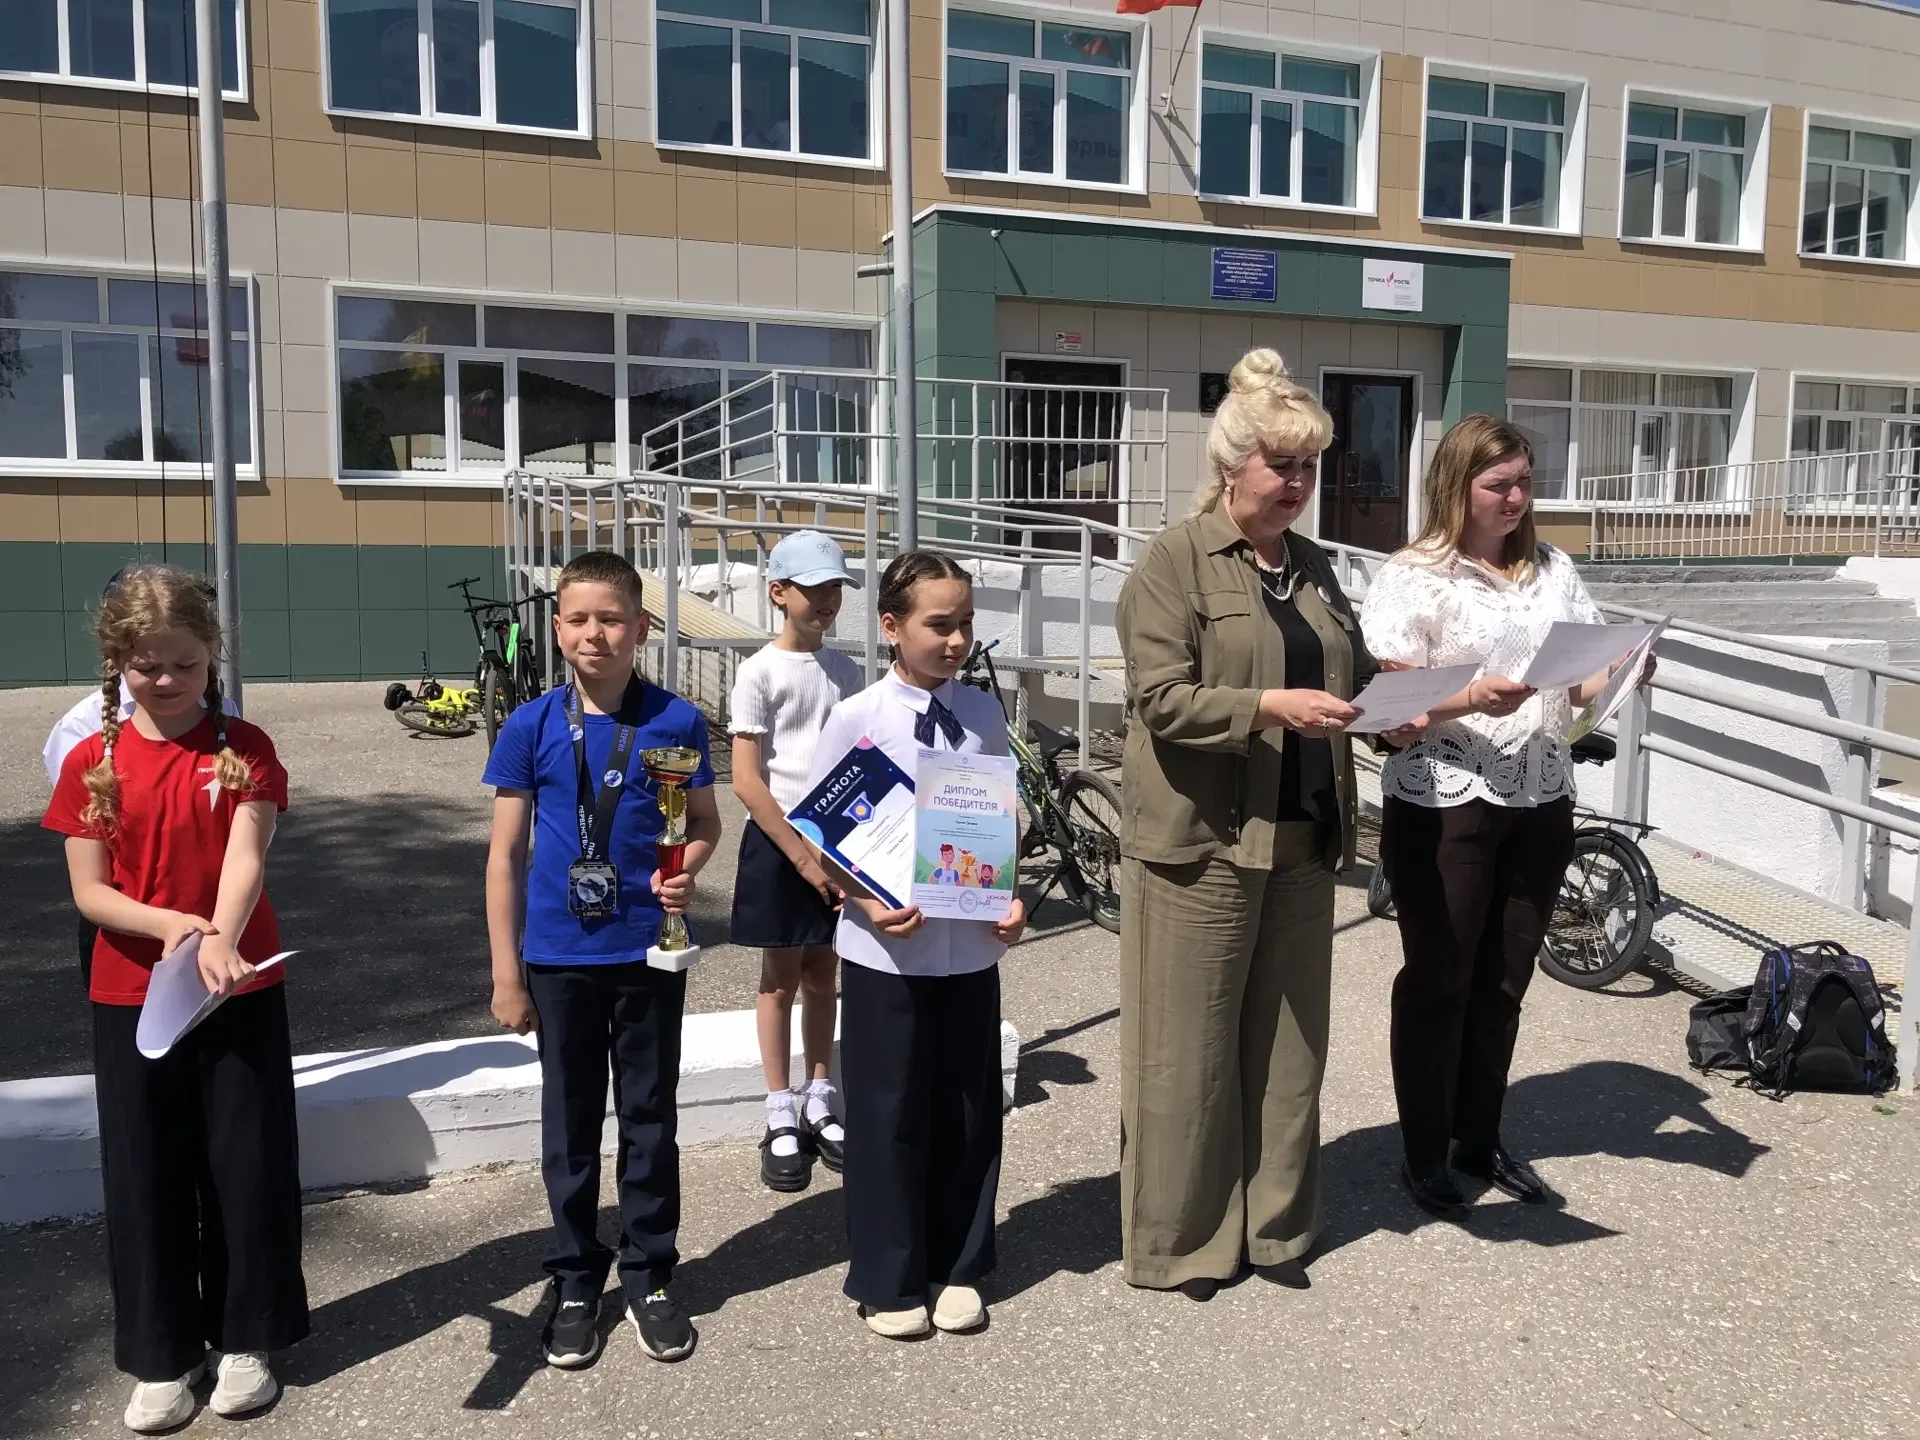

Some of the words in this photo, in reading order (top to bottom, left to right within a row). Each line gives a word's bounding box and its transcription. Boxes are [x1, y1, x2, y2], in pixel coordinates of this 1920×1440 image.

[814, 765, 861, 812] ГРАМОТА
[943, 784, 987, 797] ДИПЛОМ
[933, 796, 998, 811] ПОБЕДИТЕЛЯ
[645, 1294, 667, 1305] FILA
